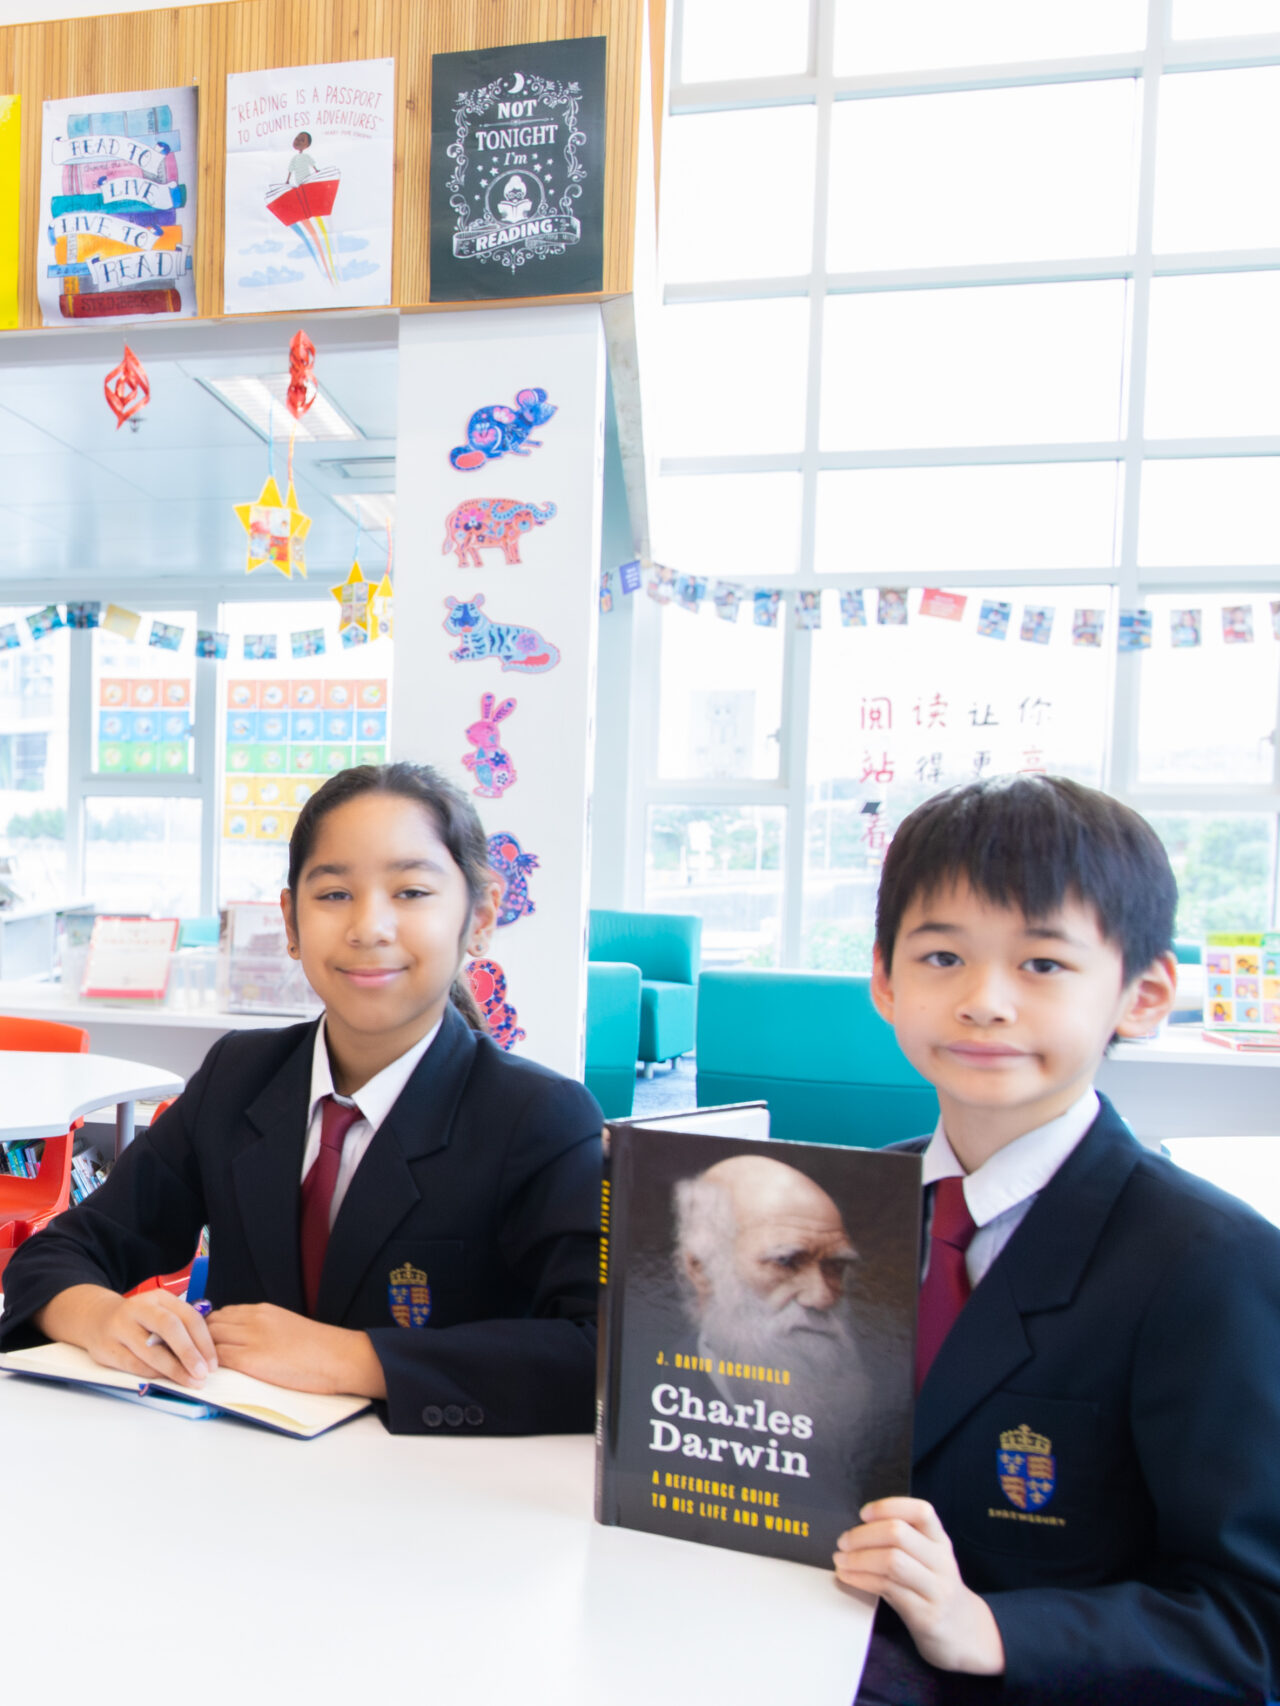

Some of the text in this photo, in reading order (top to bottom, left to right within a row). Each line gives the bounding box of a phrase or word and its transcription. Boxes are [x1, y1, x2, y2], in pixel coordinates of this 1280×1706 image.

[296, 88, 306, 105] IS
[312, 86, 320, 104] A
[325, 85, 383, 110] PASSPORT
[497, 99, 537, 119] NOT
[237, 128, 250, 145] TO
[255, 111, 311, 138] COUNTLESS
[475, 124, 559, 151] TONIGHT
[71, 138, 153, 167] READ TO
[503, 151, 528, 166] I'm
[111, 178, 159, 207] LIVE
[62, 216, 112, 237] LIVE
[123, 226, 149, 248] TO
[476, 219, 553, 251] READING
[100, 251, 174, 283] READ
[860, 692, 1053, 731] 阅读让你
[656, 1351, 791, 1386] J. DAVID ARCHIBALD
[651, 1383, 814, 1440] Charles
[649, 1418, 810, 1478] Darwin
[652, 1470, 780, 1508] A REFERENCE GUIDE
[652, 1492, 809, 1537] TO HIS LIFE AND WORKS
